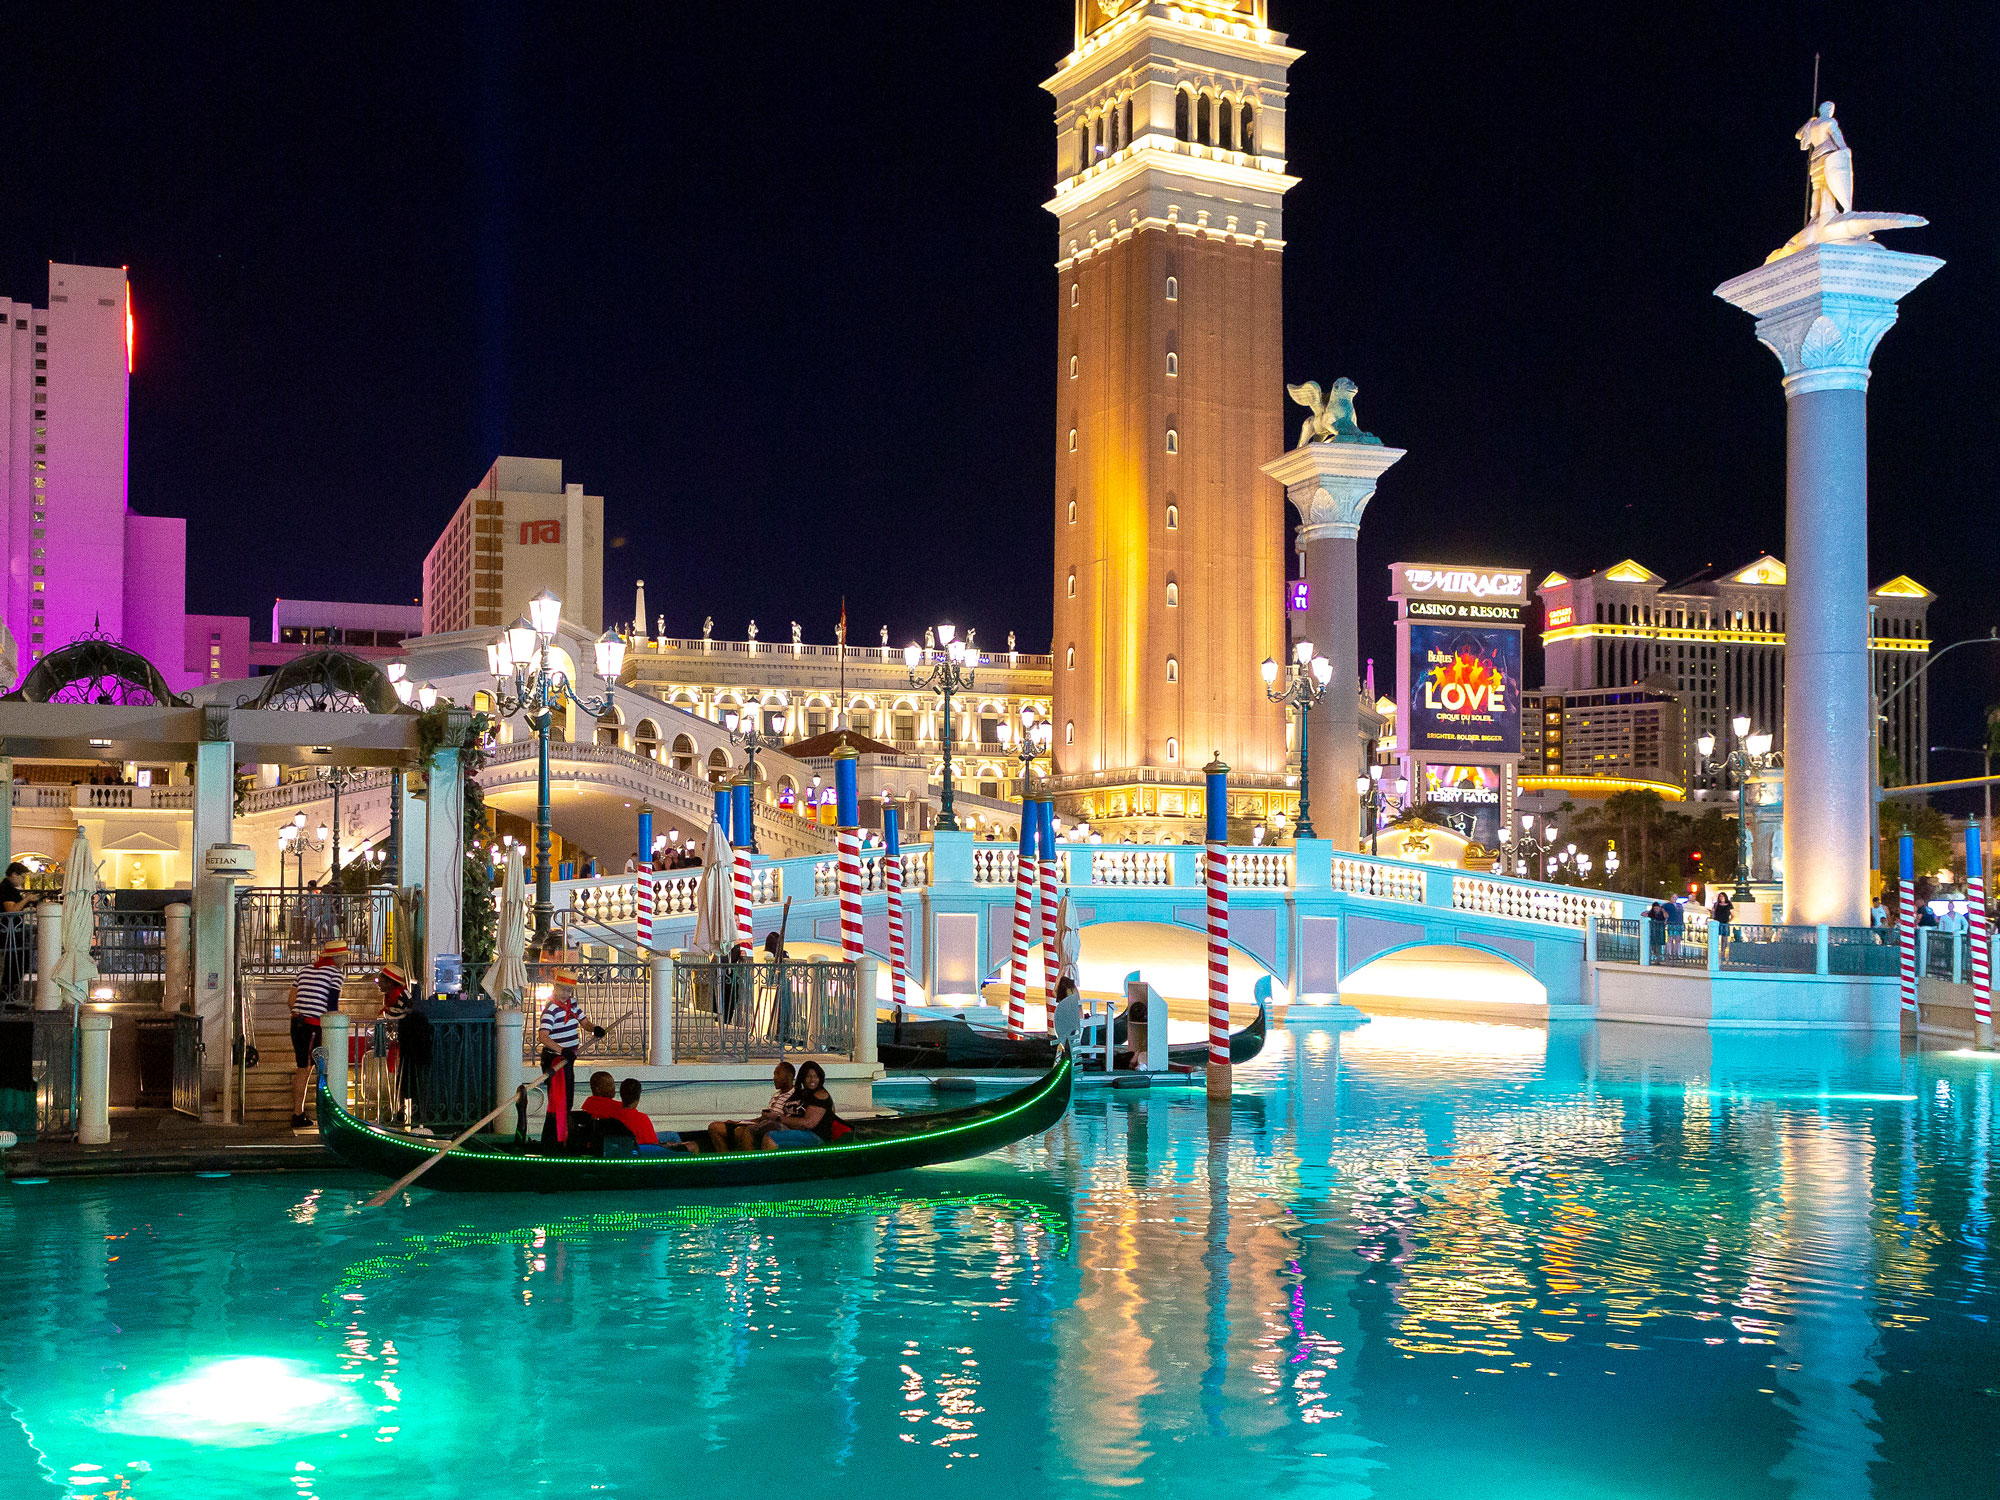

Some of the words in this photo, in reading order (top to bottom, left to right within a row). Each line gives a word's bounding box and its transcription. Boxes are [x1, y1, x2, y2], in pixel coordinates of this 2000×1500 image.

[1413, 570, 1523, 597] MIRAGE
[1410, 603, 1456, 616] CASINO
[1458, 605, 1469, 617] &
[1470, 606, 1519, 618] RESORT
[1425, 681, 1506, 712] LOVE
[1436, 713, 1460, 722] CIRQUE
[1460, 713, 1471, 721] DU
[1426, 790, 1462, 802] TERRY
[1463, 793, 1498, 803] FATOR
